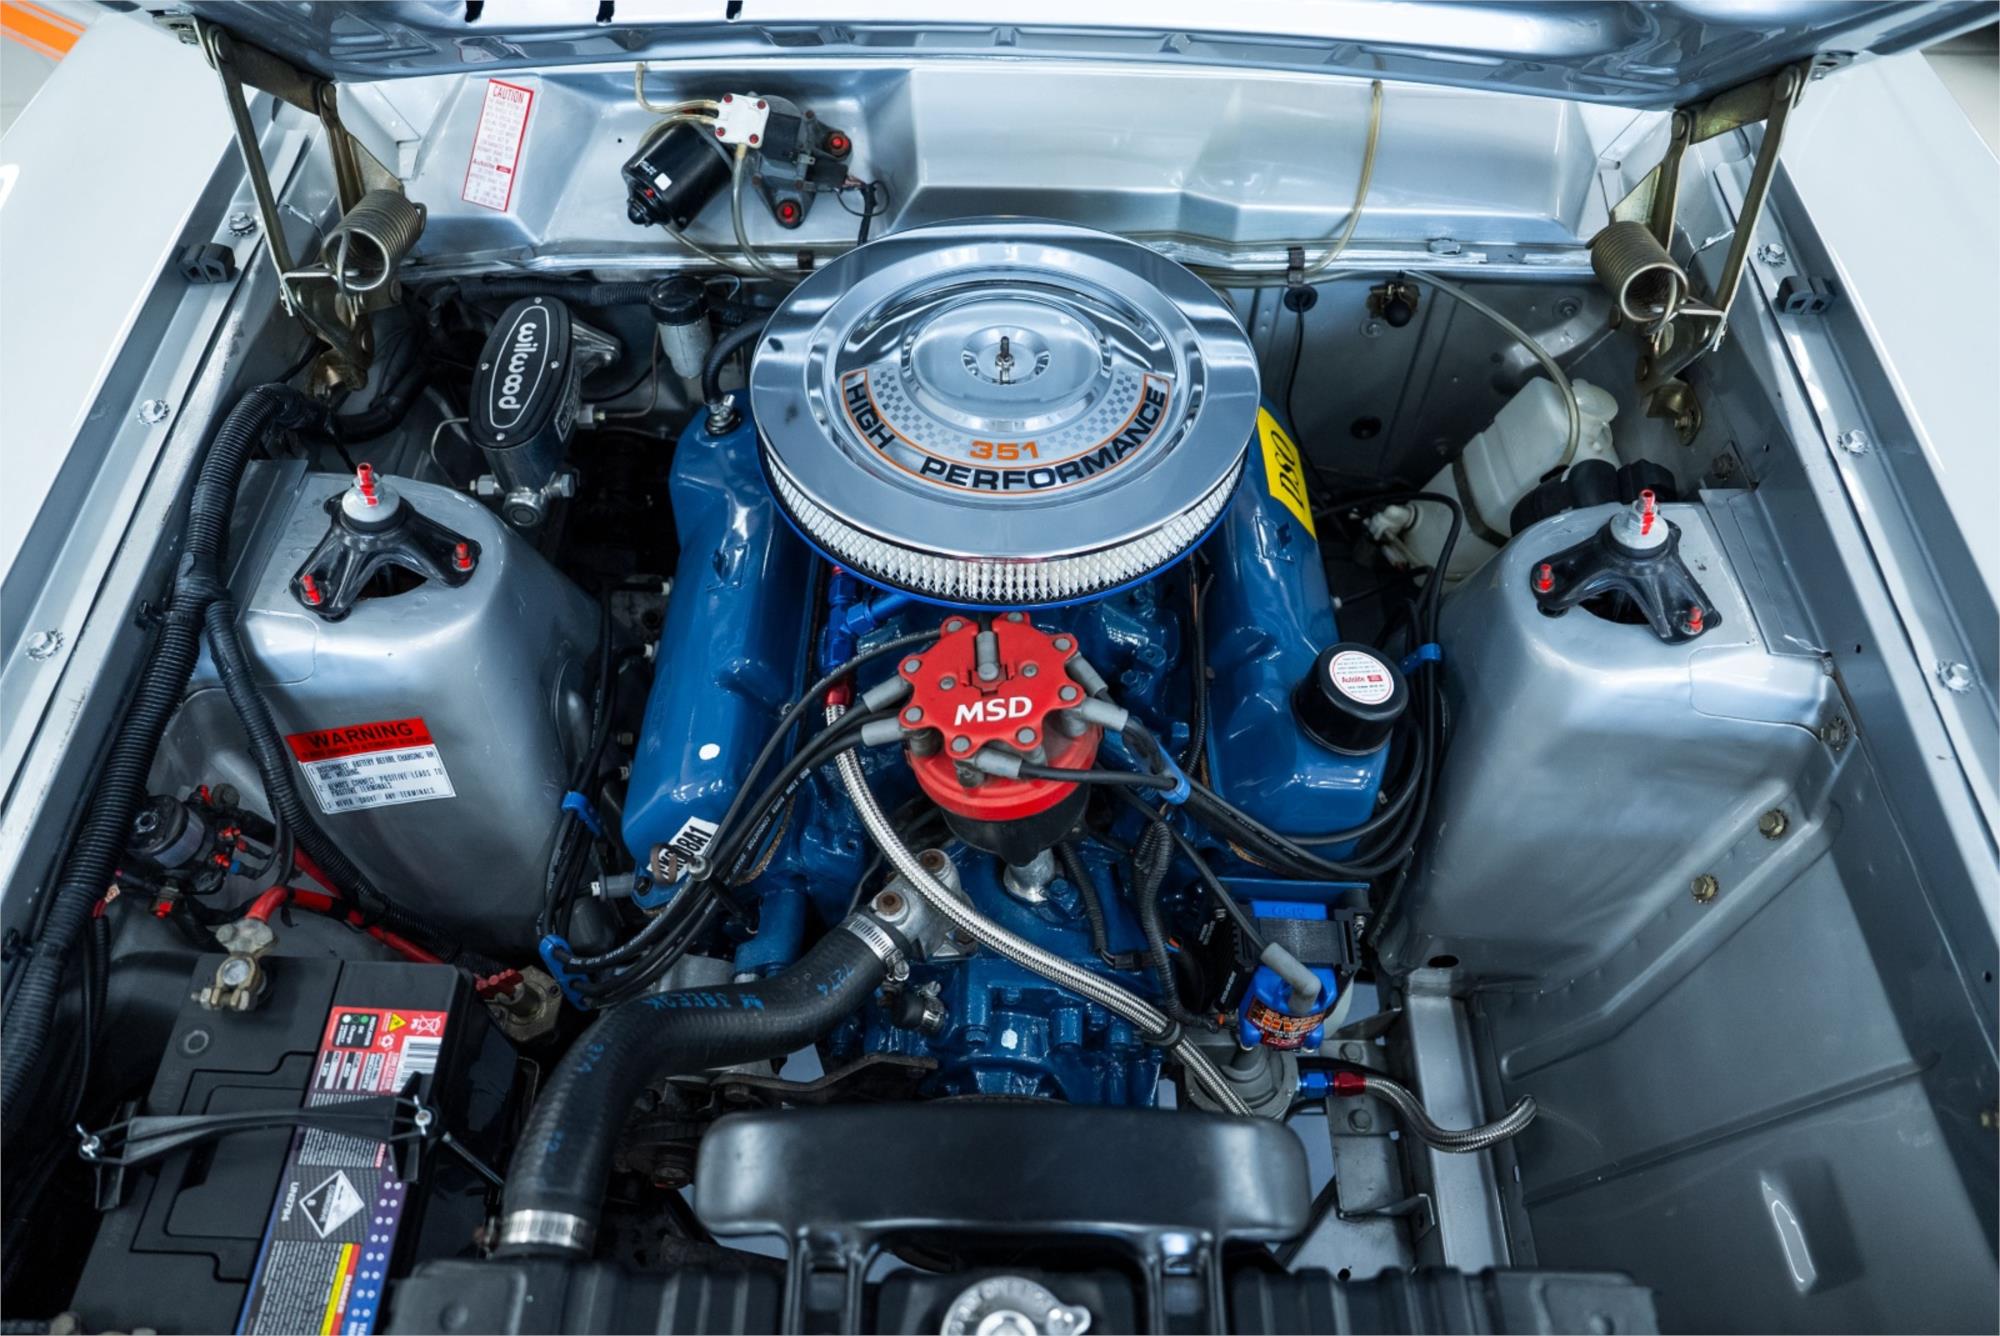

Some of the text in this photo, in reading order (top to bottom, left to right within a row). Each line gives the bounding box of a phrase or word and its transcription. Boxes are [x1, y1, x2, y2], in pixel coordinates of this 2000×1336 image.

[492, 86, 524, 104] CAUTION
[498, 322, 538, 409] wilwood
[845, 382, 1167, 490] HIGH PERFORMANCE
[969, 440, 1041, 461] 351
[954, 696, 1033, 726] MSD
[308, 722, 414, 748] WARNING
[379, 772, 408, 783] POSITIVE
[410, 769, 432, 778] LEADS
[400, 787, 436, 798] TERMINALS
